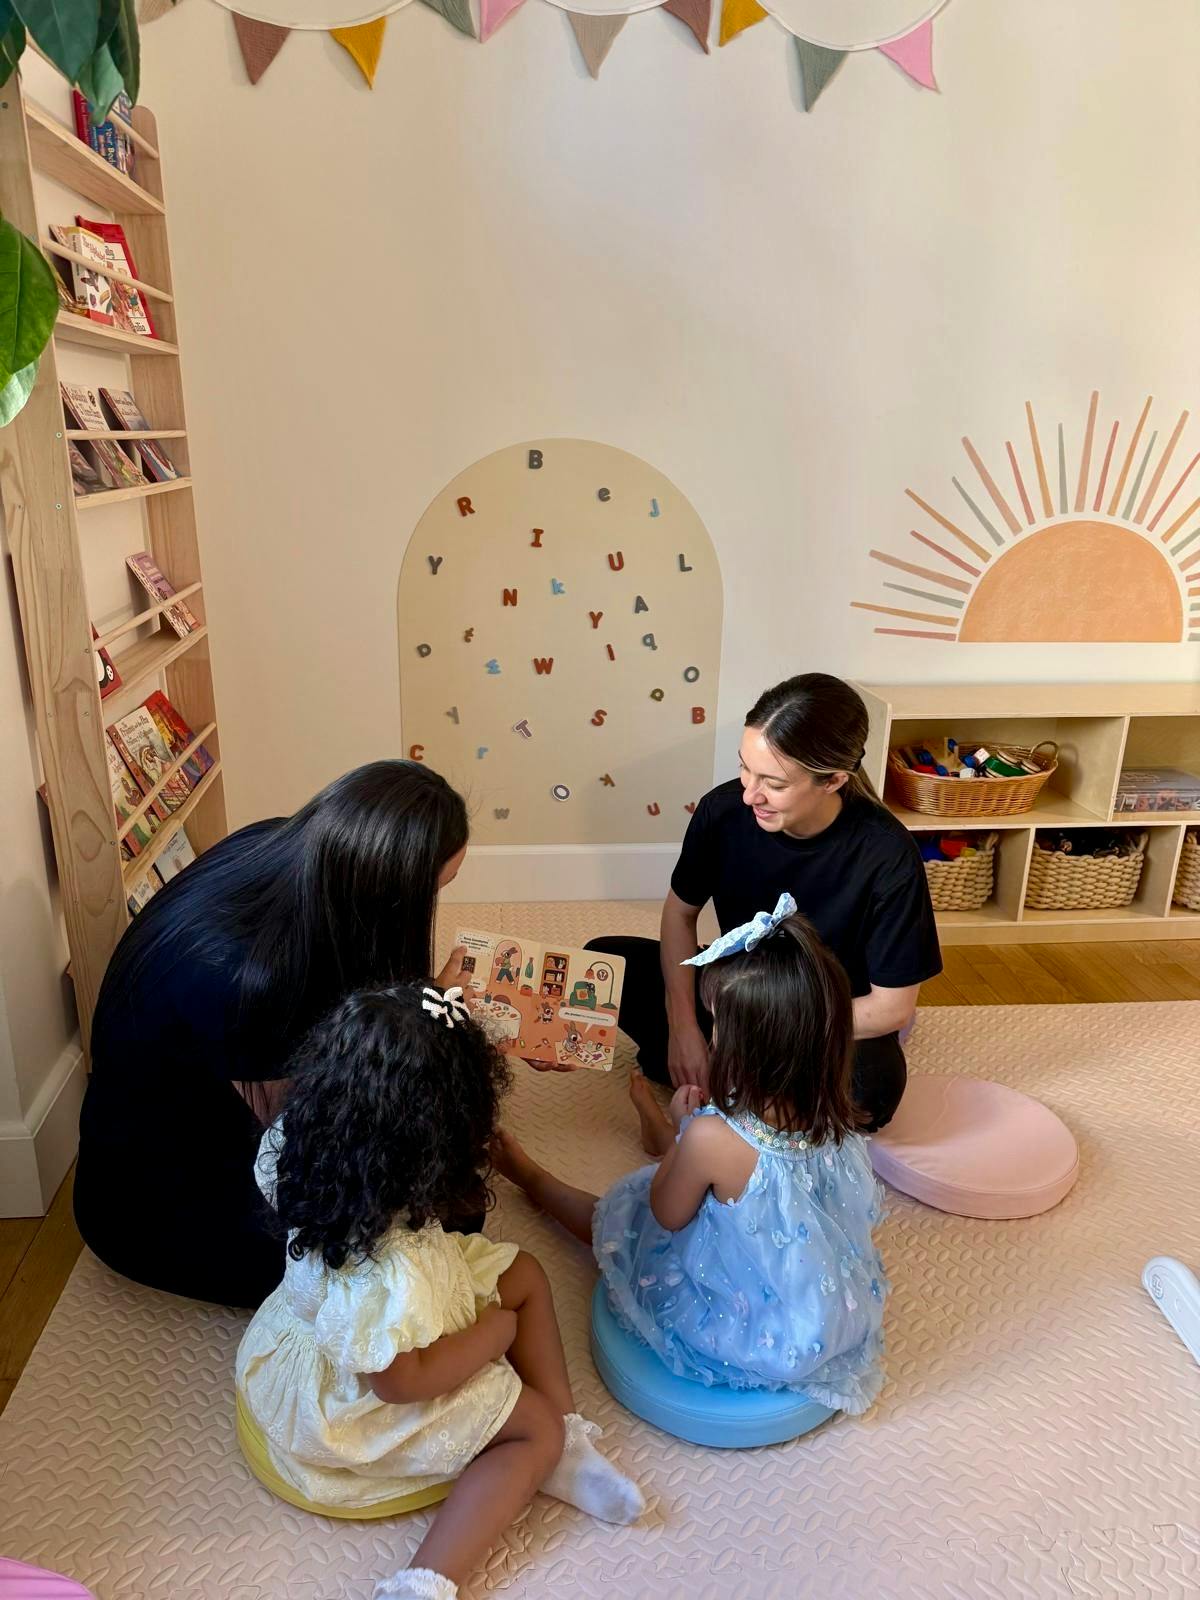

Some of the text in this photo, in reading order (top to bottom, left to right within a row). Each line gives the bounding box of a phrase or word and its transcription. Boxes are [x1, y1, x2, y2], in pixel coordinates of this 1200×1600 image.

[529, 450, 543, 469] B
[598, 488, 611, 502] e
[457, 497, 475, 517] R
[531, 528, 544, 548] I
[428, 556, 443, 575] Y
[608, 552, 624, 571] U
[678, 554, 692, 572] L
[503, 588, 517, 607] N
[634, 596, 649, 614] A
[588, 611, 603, 629] Y
[591, 709, 607, 726] S
[691, 707, 705, 724] B
[515, 719, 532, 738] T
[409, 745, 424, 761] C
